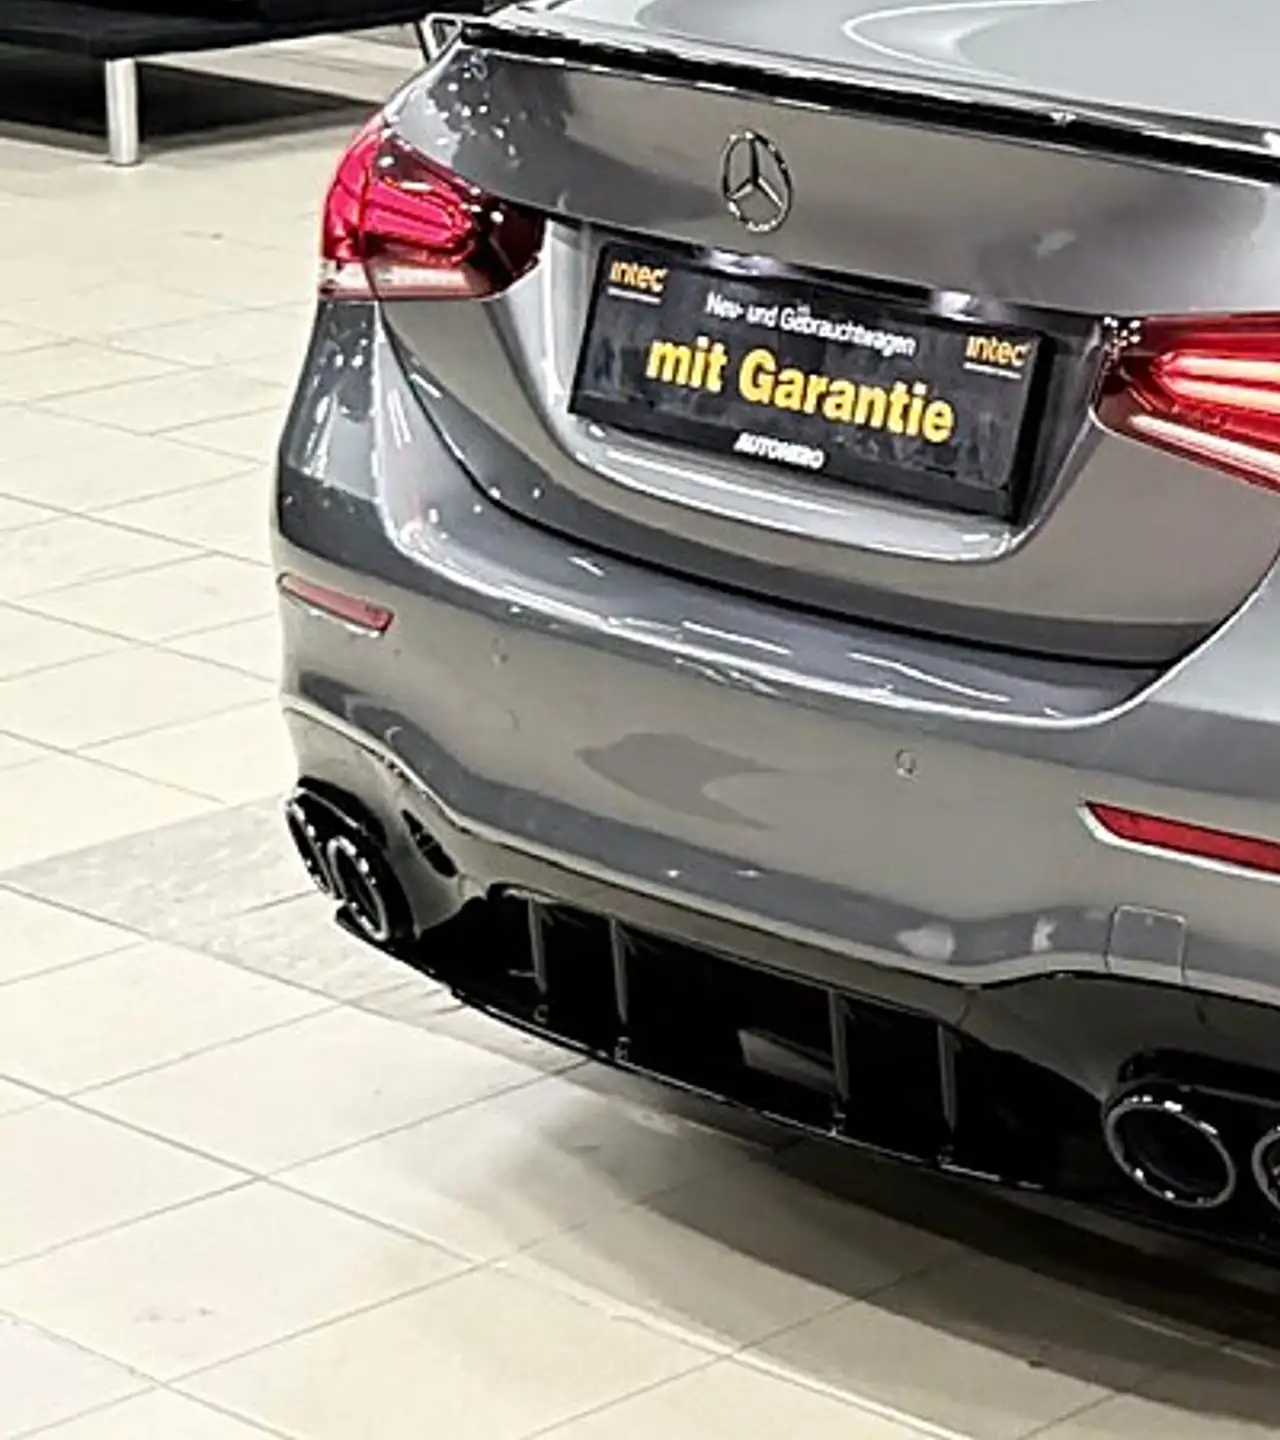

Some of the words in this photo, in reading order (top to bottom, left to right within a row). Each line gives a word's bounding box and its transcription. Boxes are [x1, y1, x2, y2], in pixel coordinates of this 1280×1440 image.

[746, 305, 779, 328] und
[780, 304, 917, 357] Gebrauchtwagen
[646, 336, 729, 393] mit
[738, 348, 955, 443] Garantie
